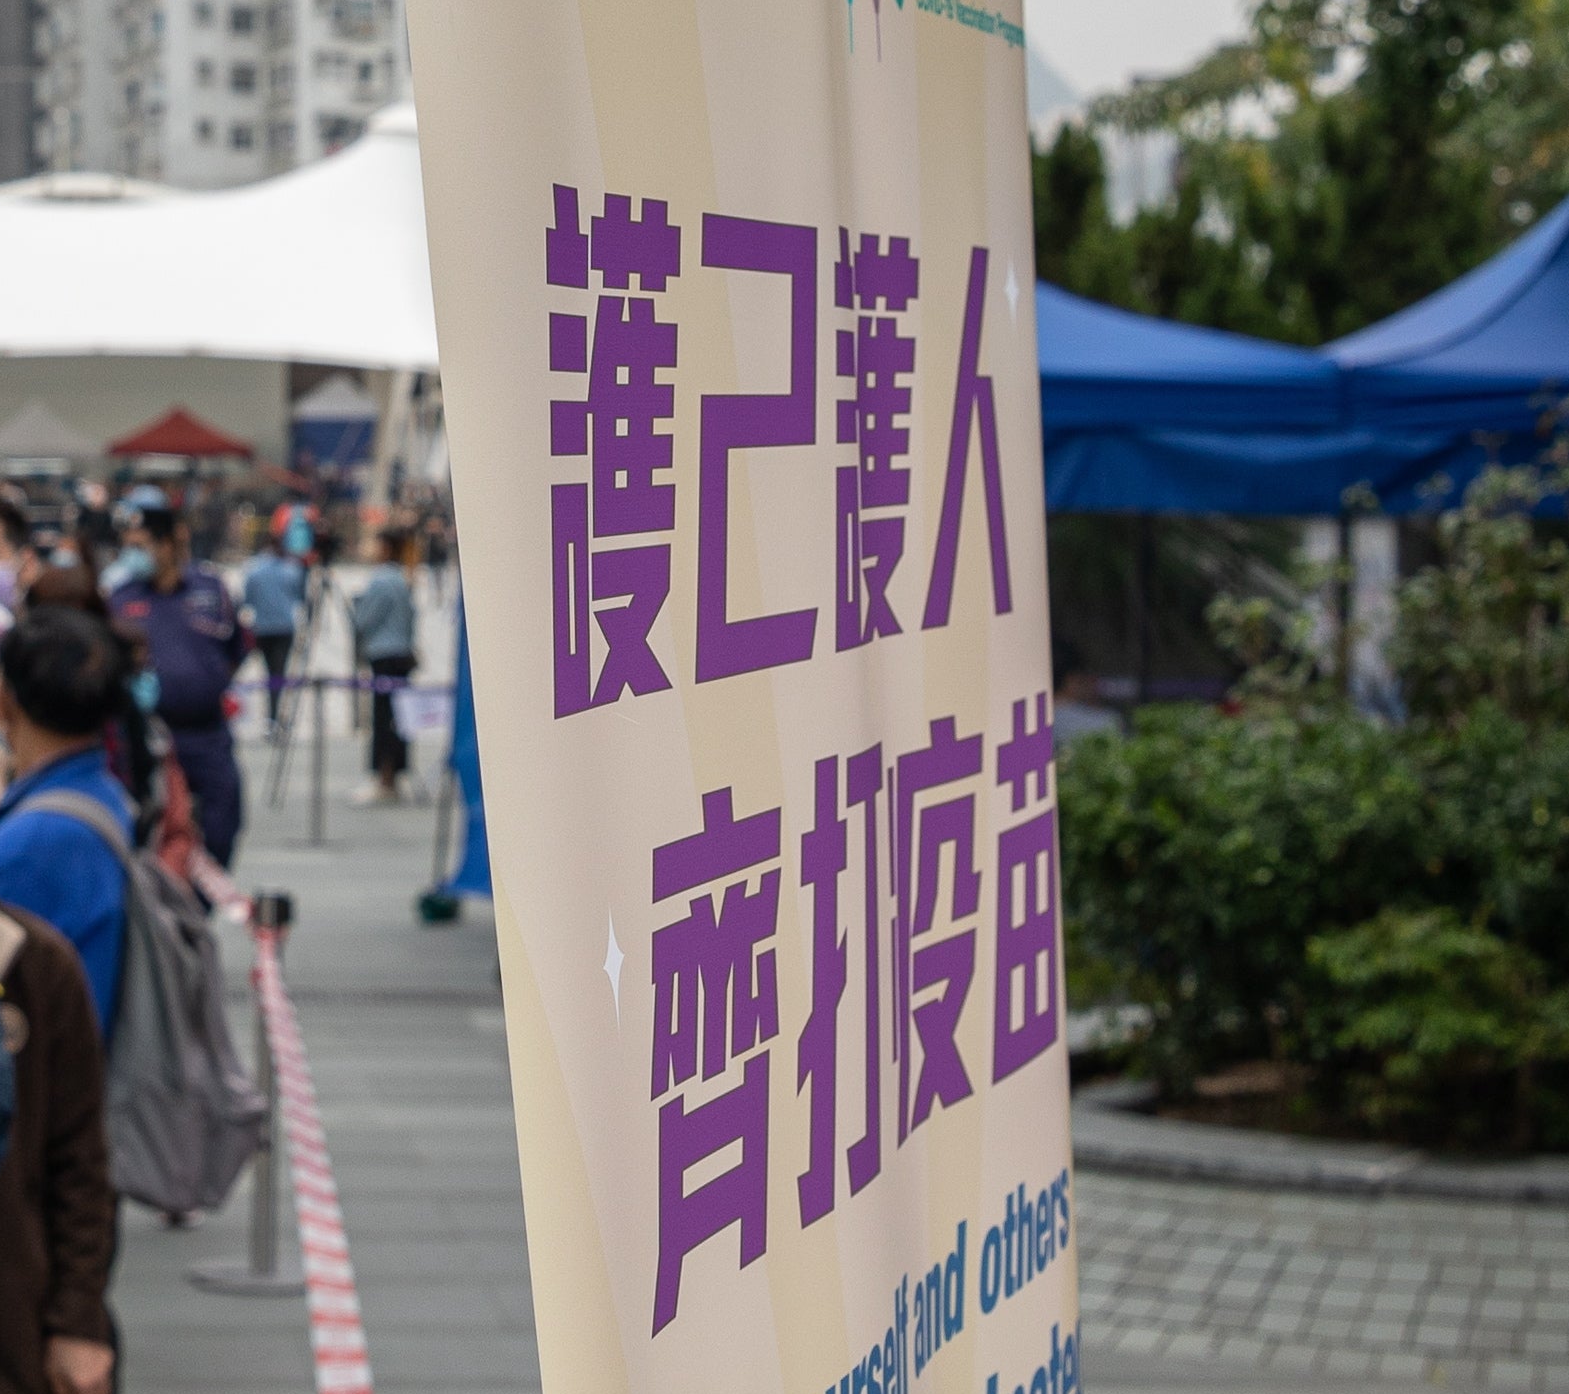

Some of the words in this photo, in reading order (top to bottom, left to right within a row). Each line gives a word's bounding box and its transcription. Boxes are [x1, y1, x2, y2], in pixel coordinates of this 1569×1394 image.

[546, 183, 1013, 720] 護己護人
[651, 691, 1059, 1339] 齊打疫苗
[914, 1218, 967, 1380] and
[979, 1166, 1070, 1316] others
